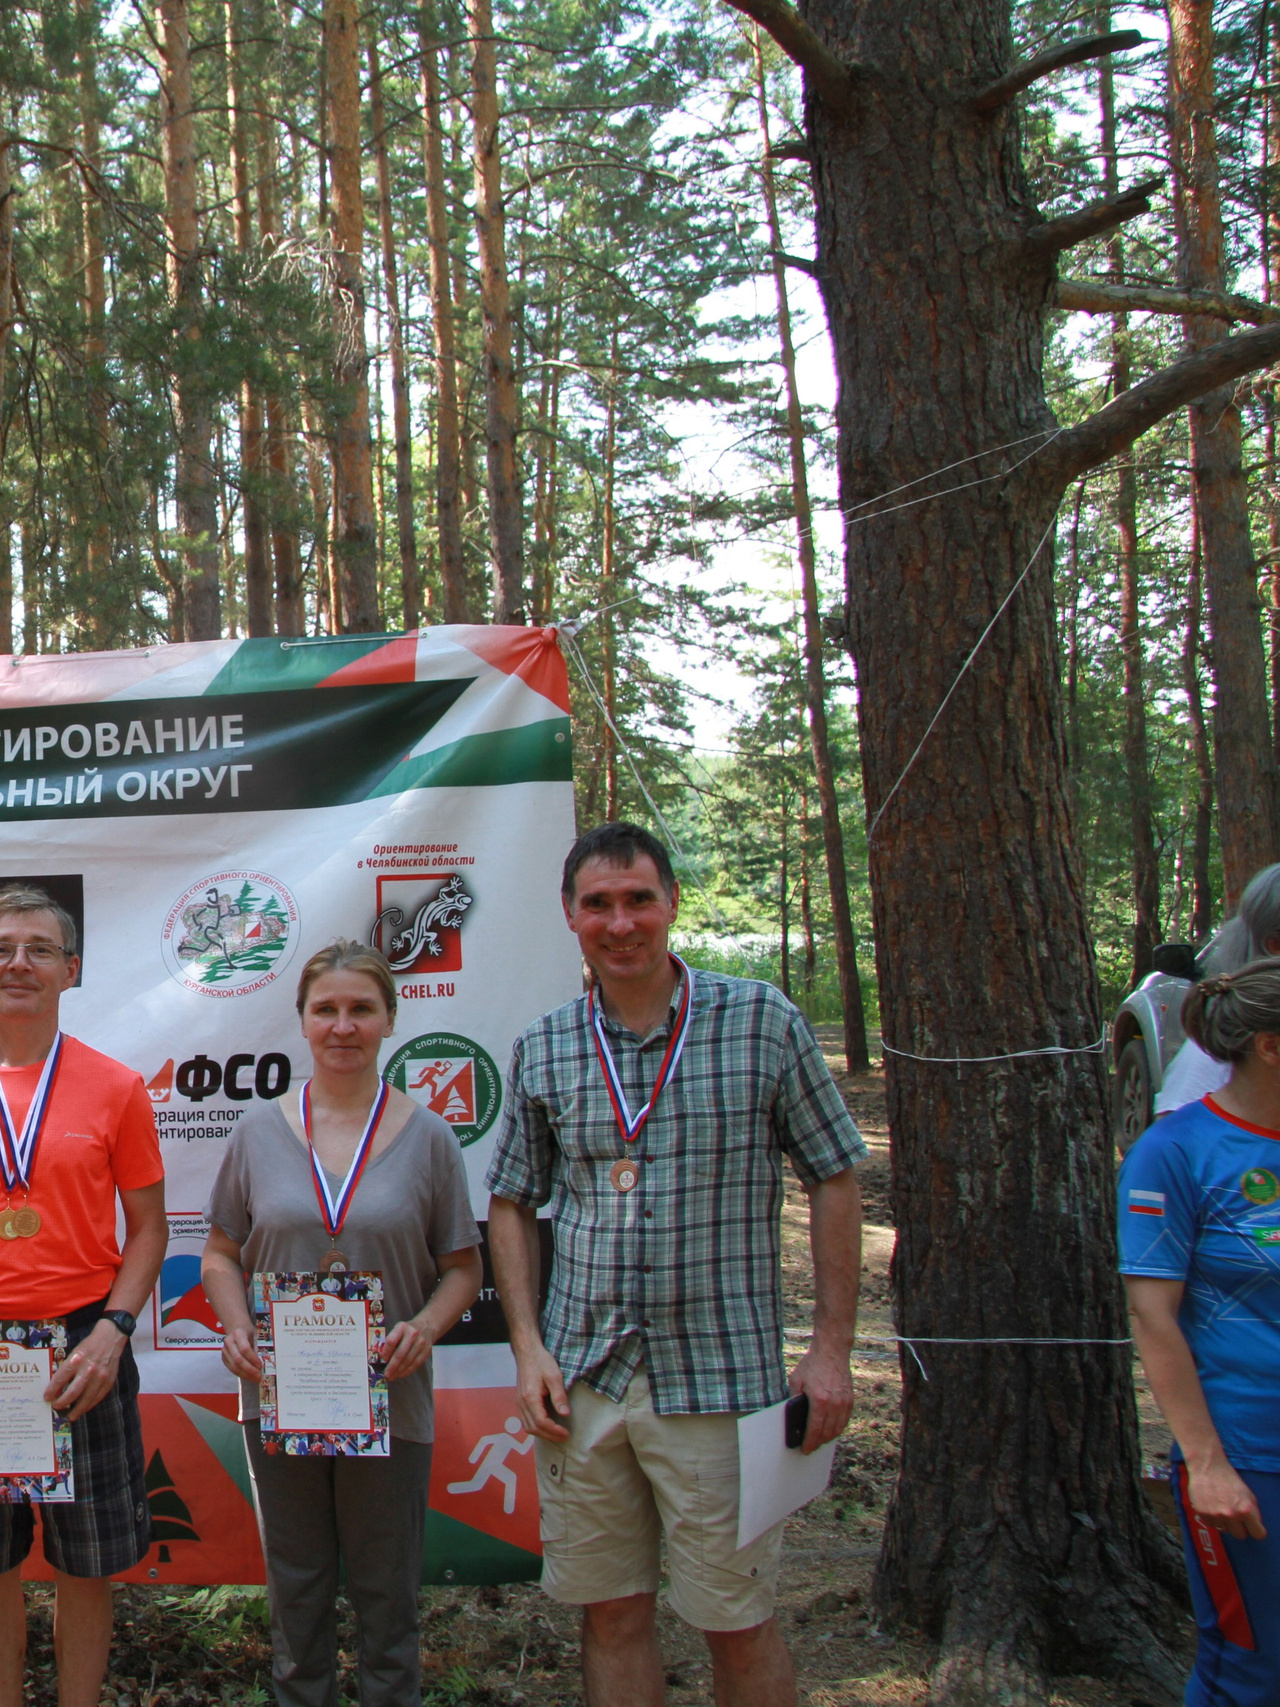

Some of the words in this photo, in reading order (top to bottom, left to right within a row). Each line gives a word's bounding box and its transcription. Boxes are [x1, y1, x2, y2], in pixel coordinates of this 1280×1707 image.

[116, 764, 253, 802] ОКРУГ
[357, 860, 363, 868] в
[366, 856, 430, 868] Челябинской
[432, 856, 475, 867] области
[373, 843, 458, 857] Ориентирование
[163, 893, 191, 940] ФЕДЕРАЦИЯ
[189, 872, 248, 896] СПОРТИВНОГО
[249, 873, 298, 922] ОРИЕНТИРОВАНИЯ
[183, 978, 235, 997] КУРГАНСКОЙ
[236, 972, 276, 996] ОБЛАСТИ
[396, 983, 456, 999] -CHEL.RU
[175, 1052, 291, 1102] ФСО
[387, 1049, 412, 1085] ДЕРАЦИЯ
[415, 1038, 476, 1055] СПОРТИВНОГО
[475, 1057, 496, 1131] ОРИЕНТИРОВАНИЯ
[283, 1315, 356, 1326] ГРАМОТА
